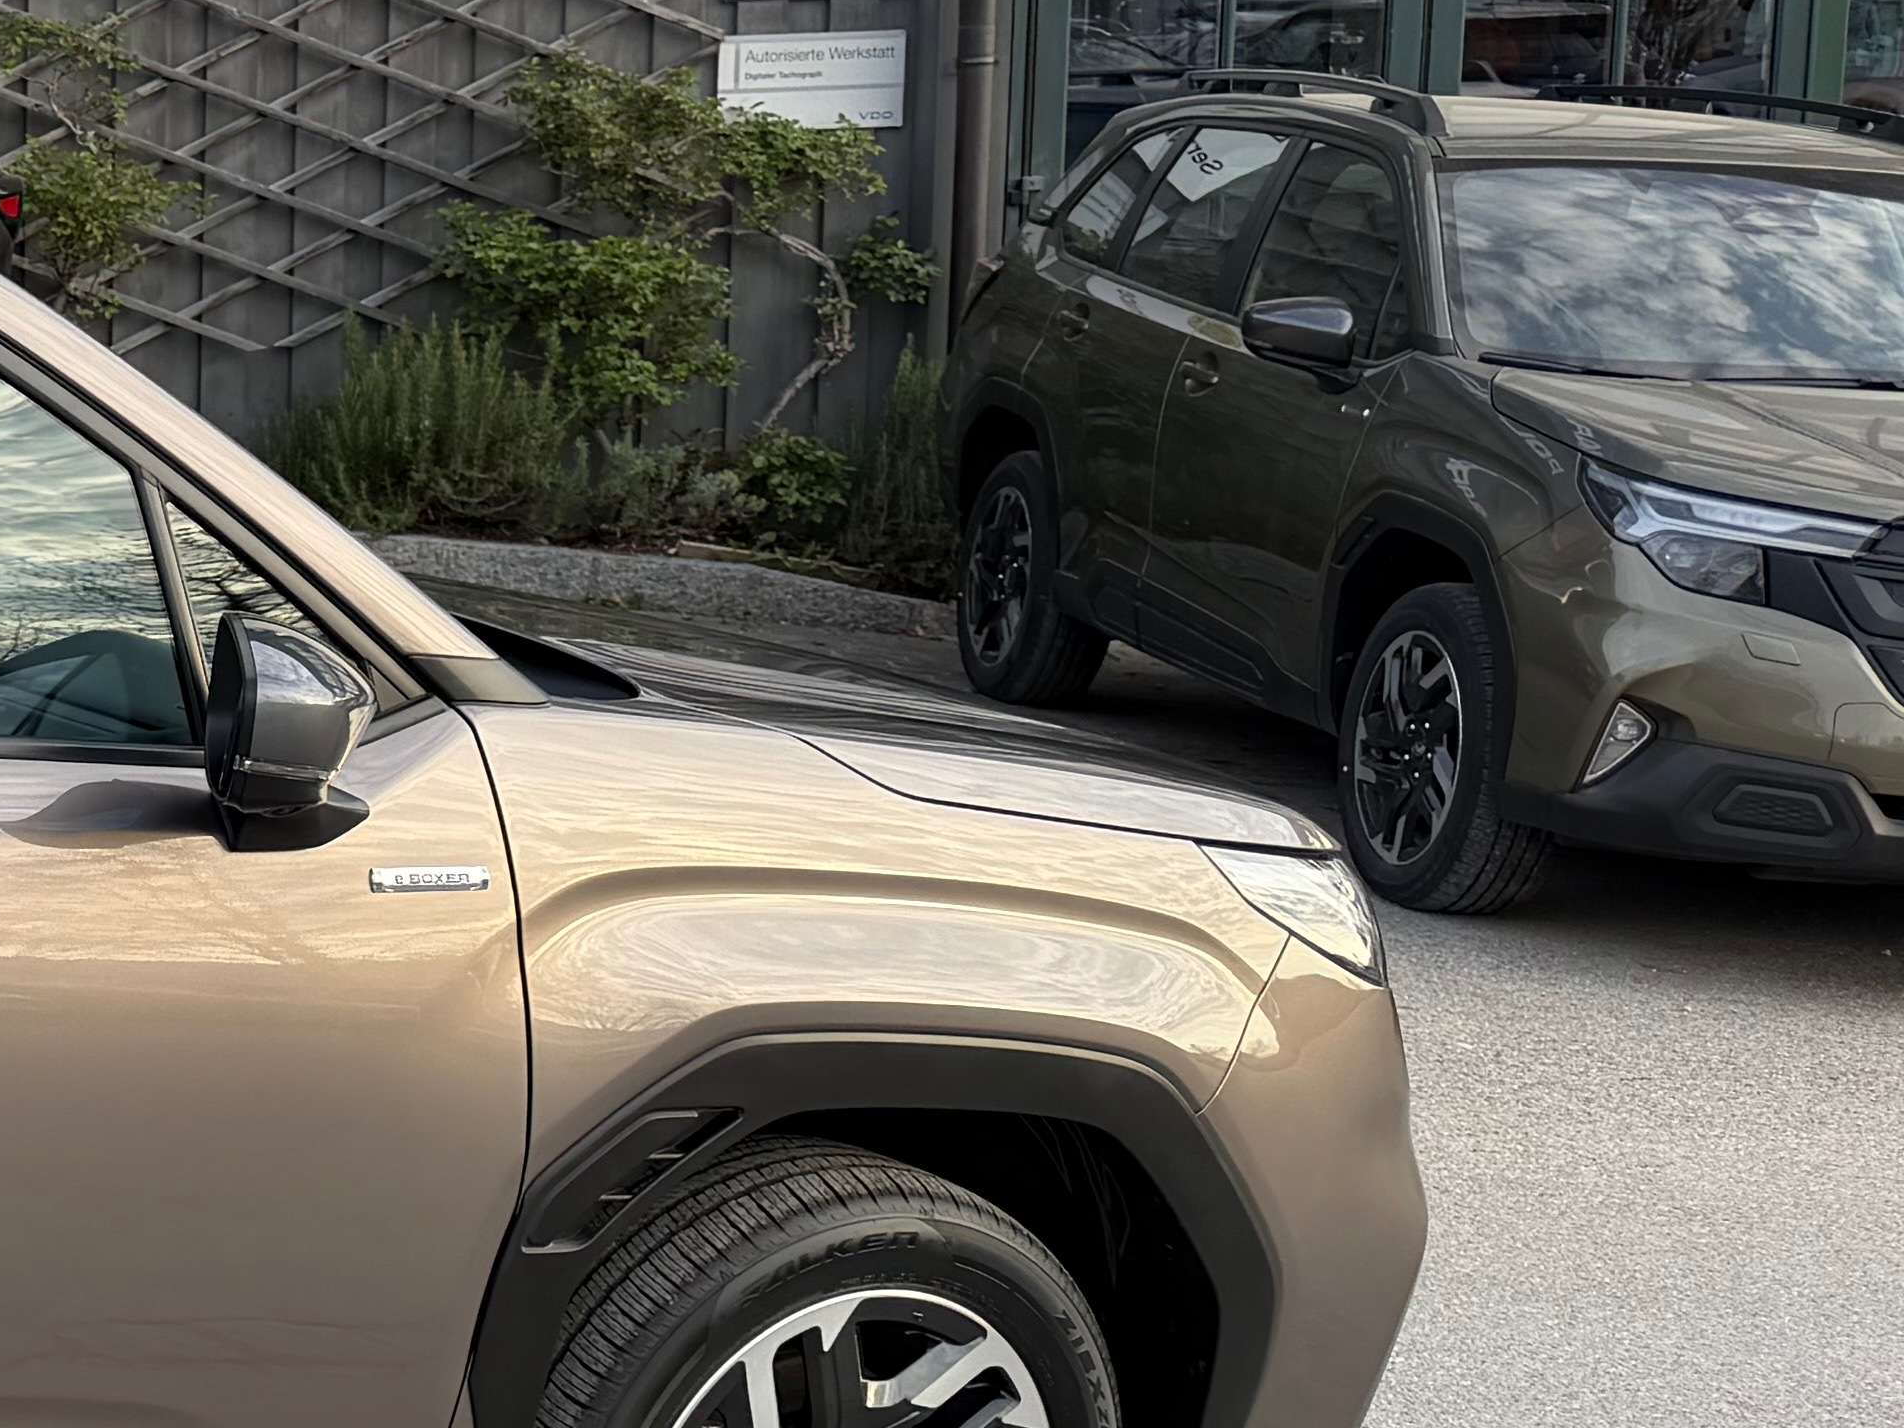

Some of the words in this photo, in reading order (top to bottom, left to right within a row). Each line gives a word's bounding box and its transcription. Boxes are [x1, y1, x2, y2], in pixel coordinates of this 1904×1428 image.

[745, 49, 825, 63] Autorisierte
[828, 46, 896, 60] Werkstatt
[858, 110, 894, 120] VDO
